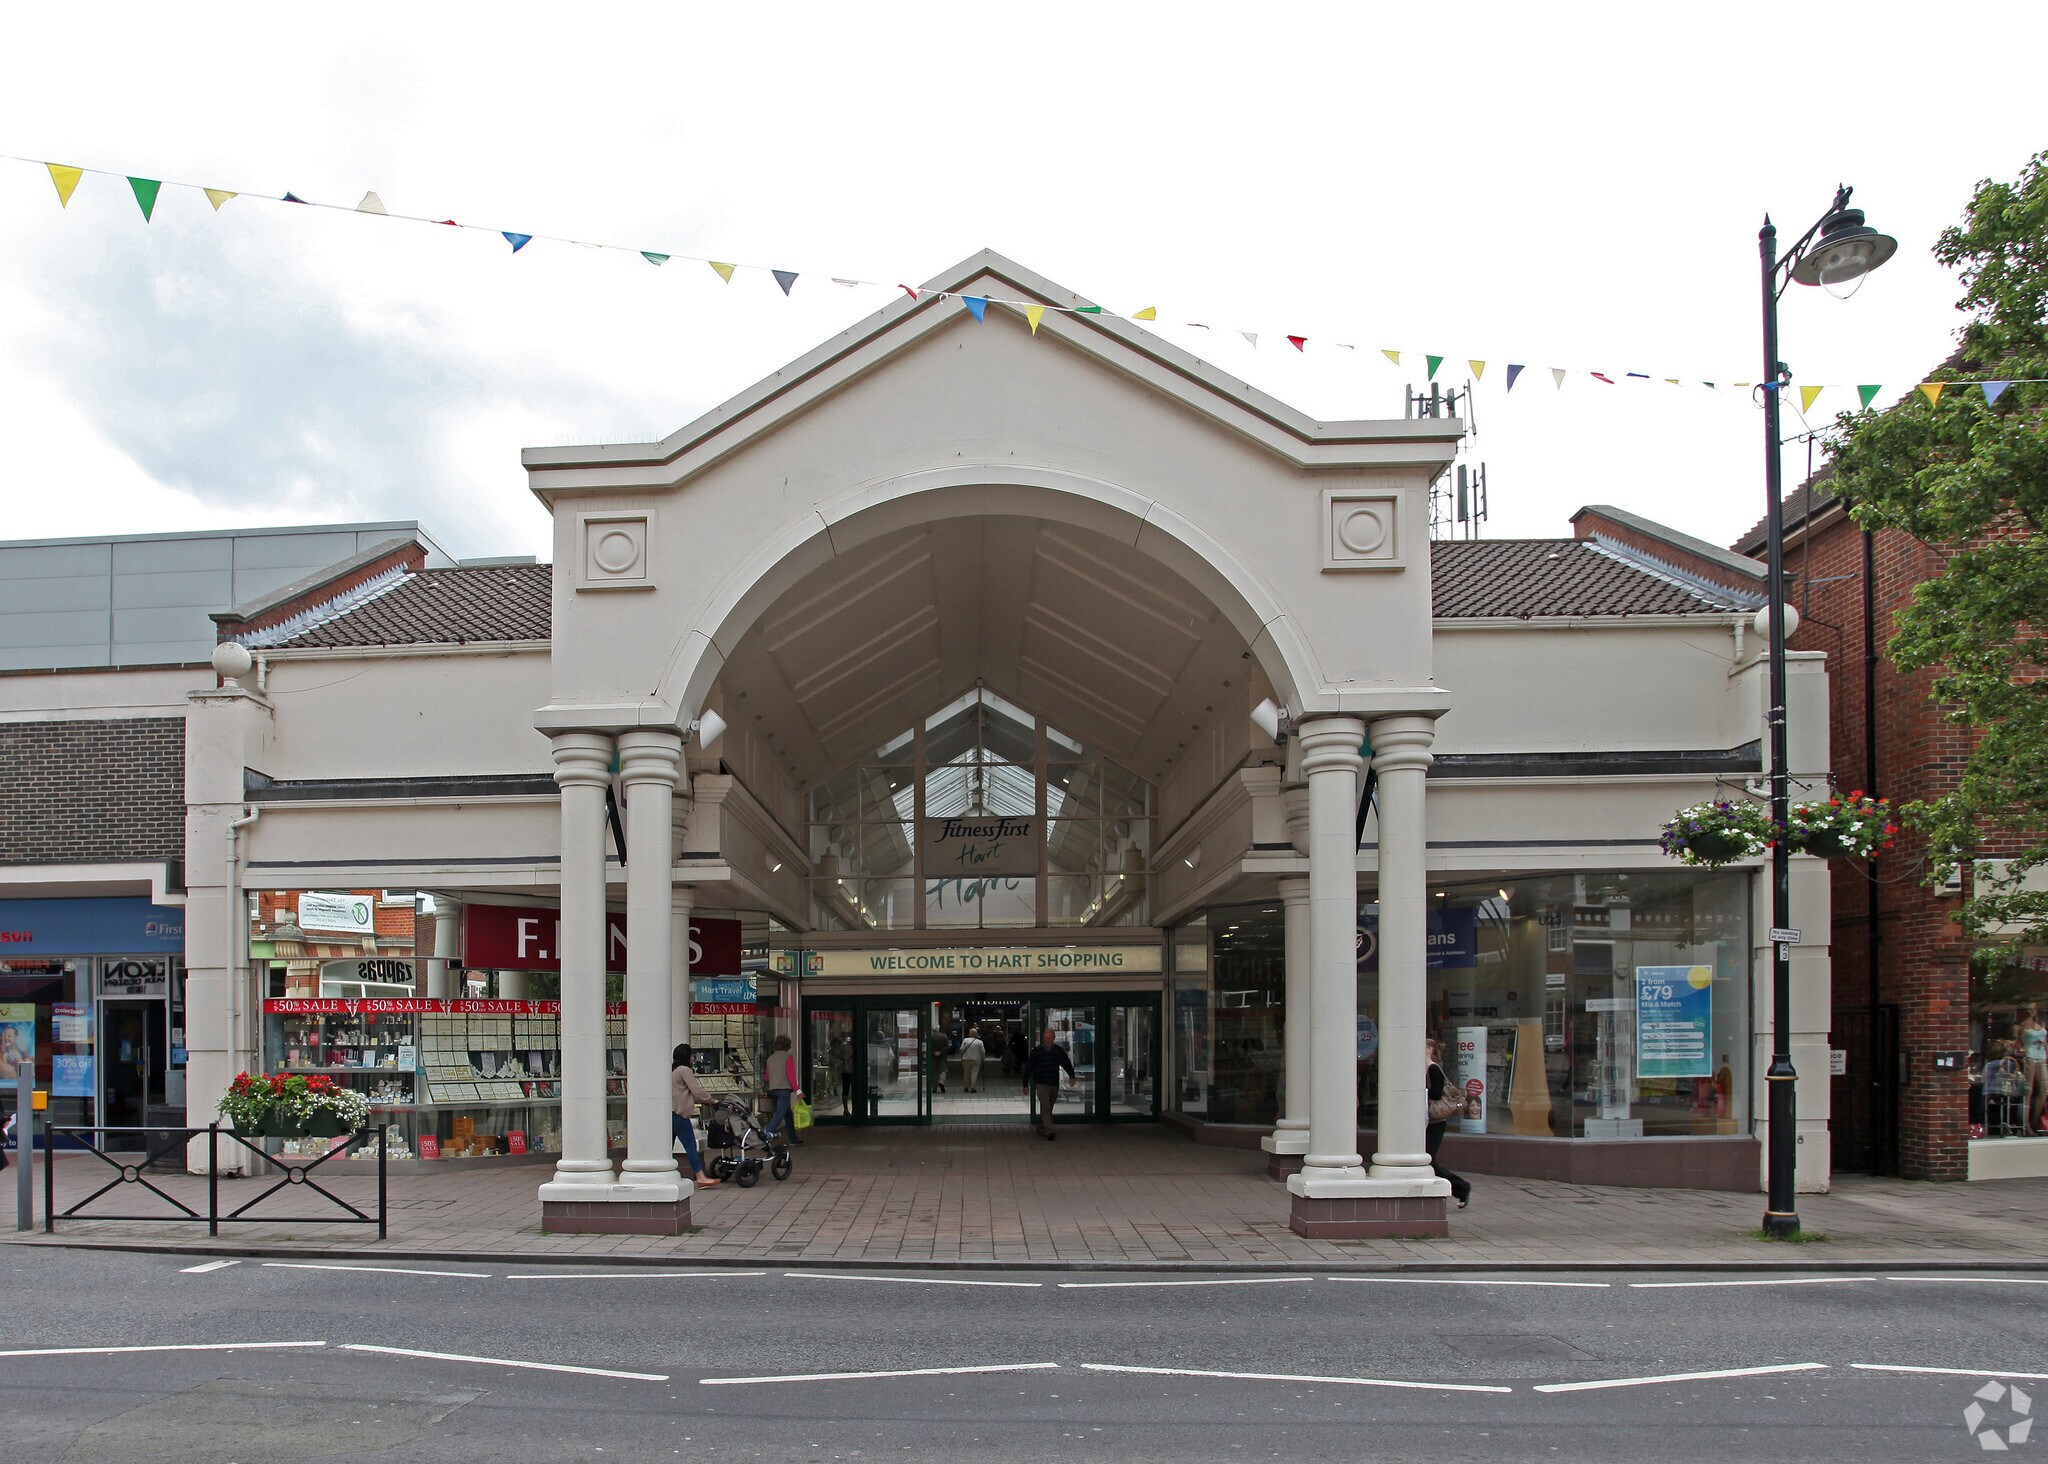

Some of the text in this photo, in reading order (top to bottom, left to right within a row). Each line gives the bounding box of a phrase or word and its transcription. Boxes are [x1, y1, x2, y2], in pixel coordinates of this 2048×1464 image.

[988, 818, 1030, 842] First
[955, 842, 1005, 865] Hart
[1538, 912, 1562, 926] U23
[159, 924, 182, 935] First
[870, 953, 1124, 969] WELCOME TO HART SHOPPING
[701, 986, 743, 995] Hart Travel
[302, 1000, 339, 1010] SALE
[396, 1000, 433, 1010] SALE
[488, 1001, 522, 1011] SALE
[722, 1004, 749, 1013] SALE
[56, 1057, 93, 1069] 30% off
